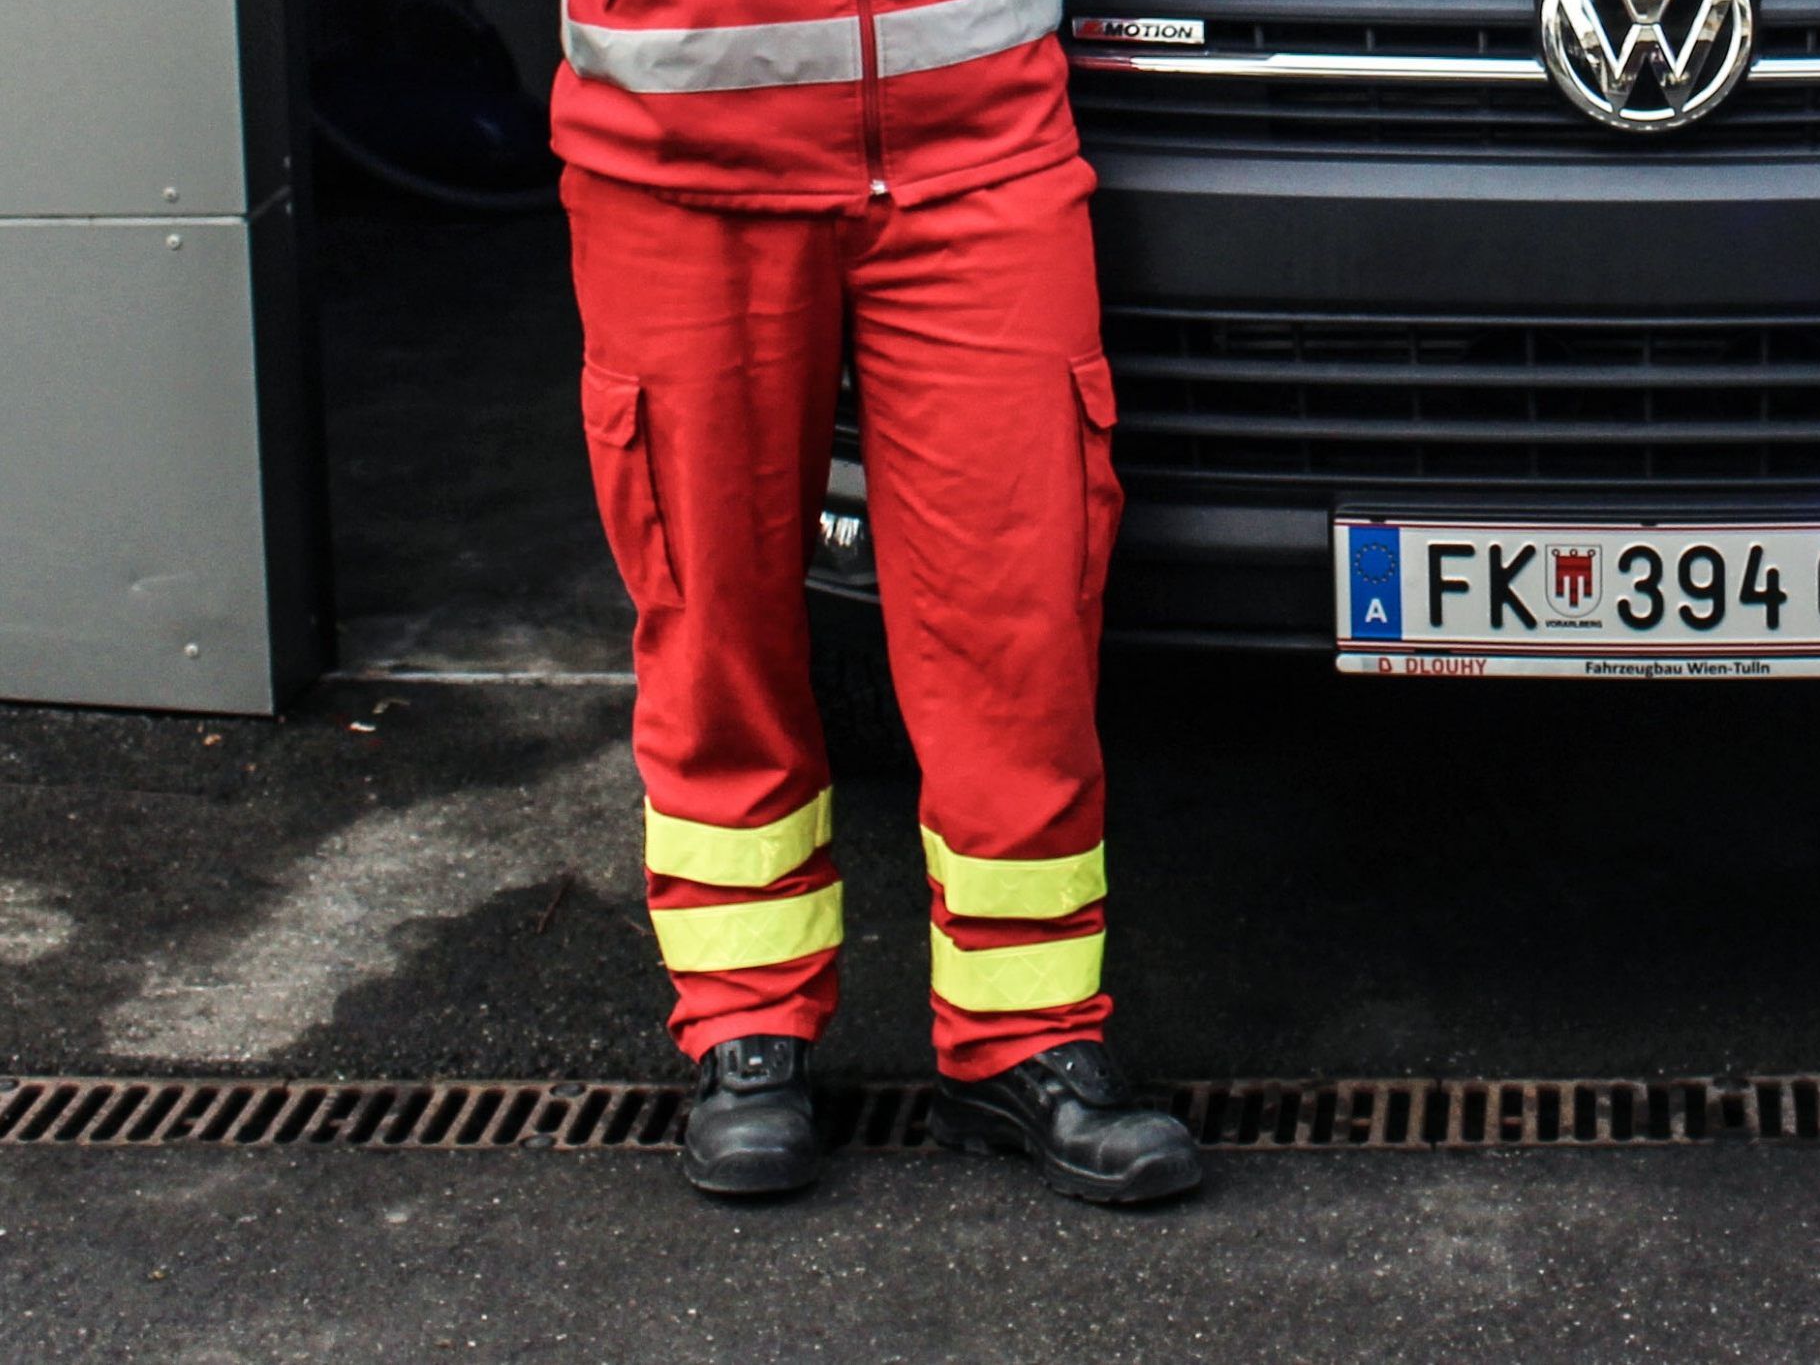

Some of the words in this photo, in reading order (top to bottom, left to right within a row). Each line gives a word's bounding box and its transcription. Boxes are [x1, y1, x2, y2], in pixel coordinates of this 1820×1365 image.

[1427, 543, 1538, 630] FK
[1616, 543, 1788, 631] 394
[1364, 599, 1388, 624] A
[1405, 658, 1487, 675] DLOUHY
[1585, 661, 1683, 677] Fahrzeugbau
[1686, 660, 1770, 675] Wien-Tulln
